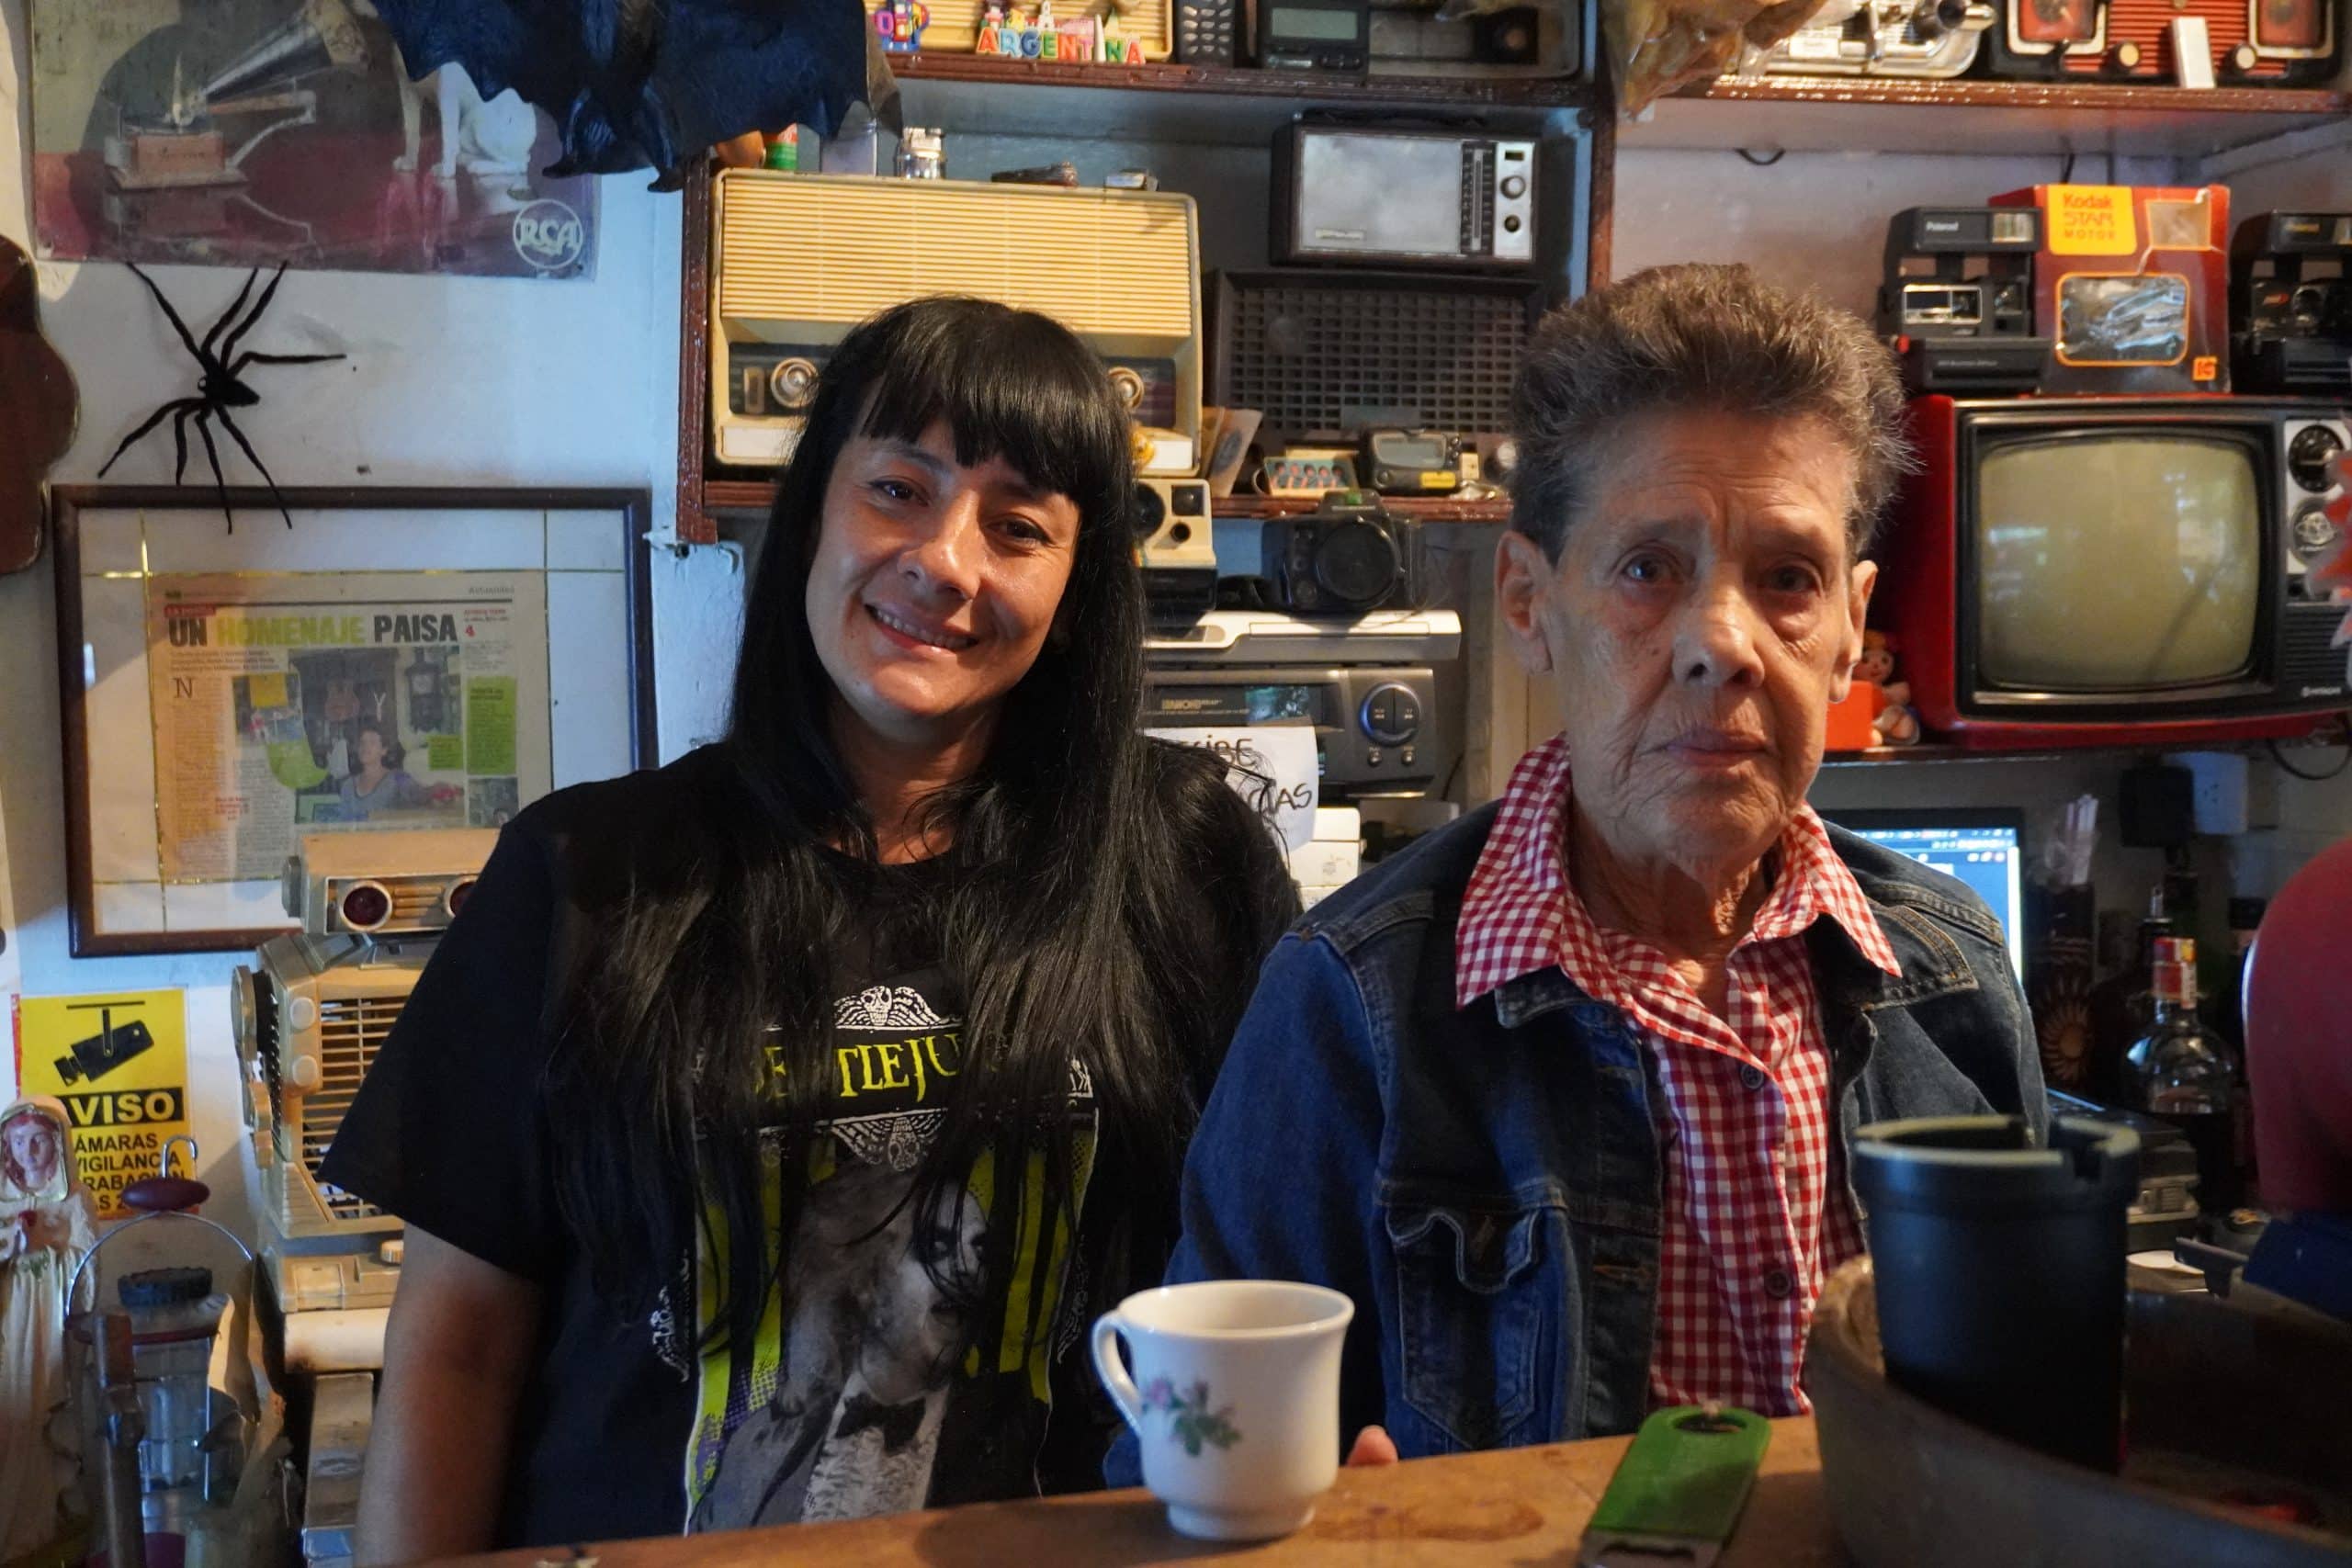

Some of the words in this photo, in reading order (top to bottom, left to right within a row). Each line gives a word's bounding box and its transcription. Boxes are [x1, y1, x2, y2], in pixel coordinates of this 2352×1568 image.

[2064, 193, 2112, 209] Kodak
[2064, 211, 2115, 227] STAR
[519, 218, 580, 256] RCA
[168, 616, 208, 647] UN
[217, 616, 366, 647] HOMENAJE
[373, 614, 458, 643] PAISA
[70, 1090, 175, 1126] VISO
[74, 1133, 159, 1155] ÁMARAS
